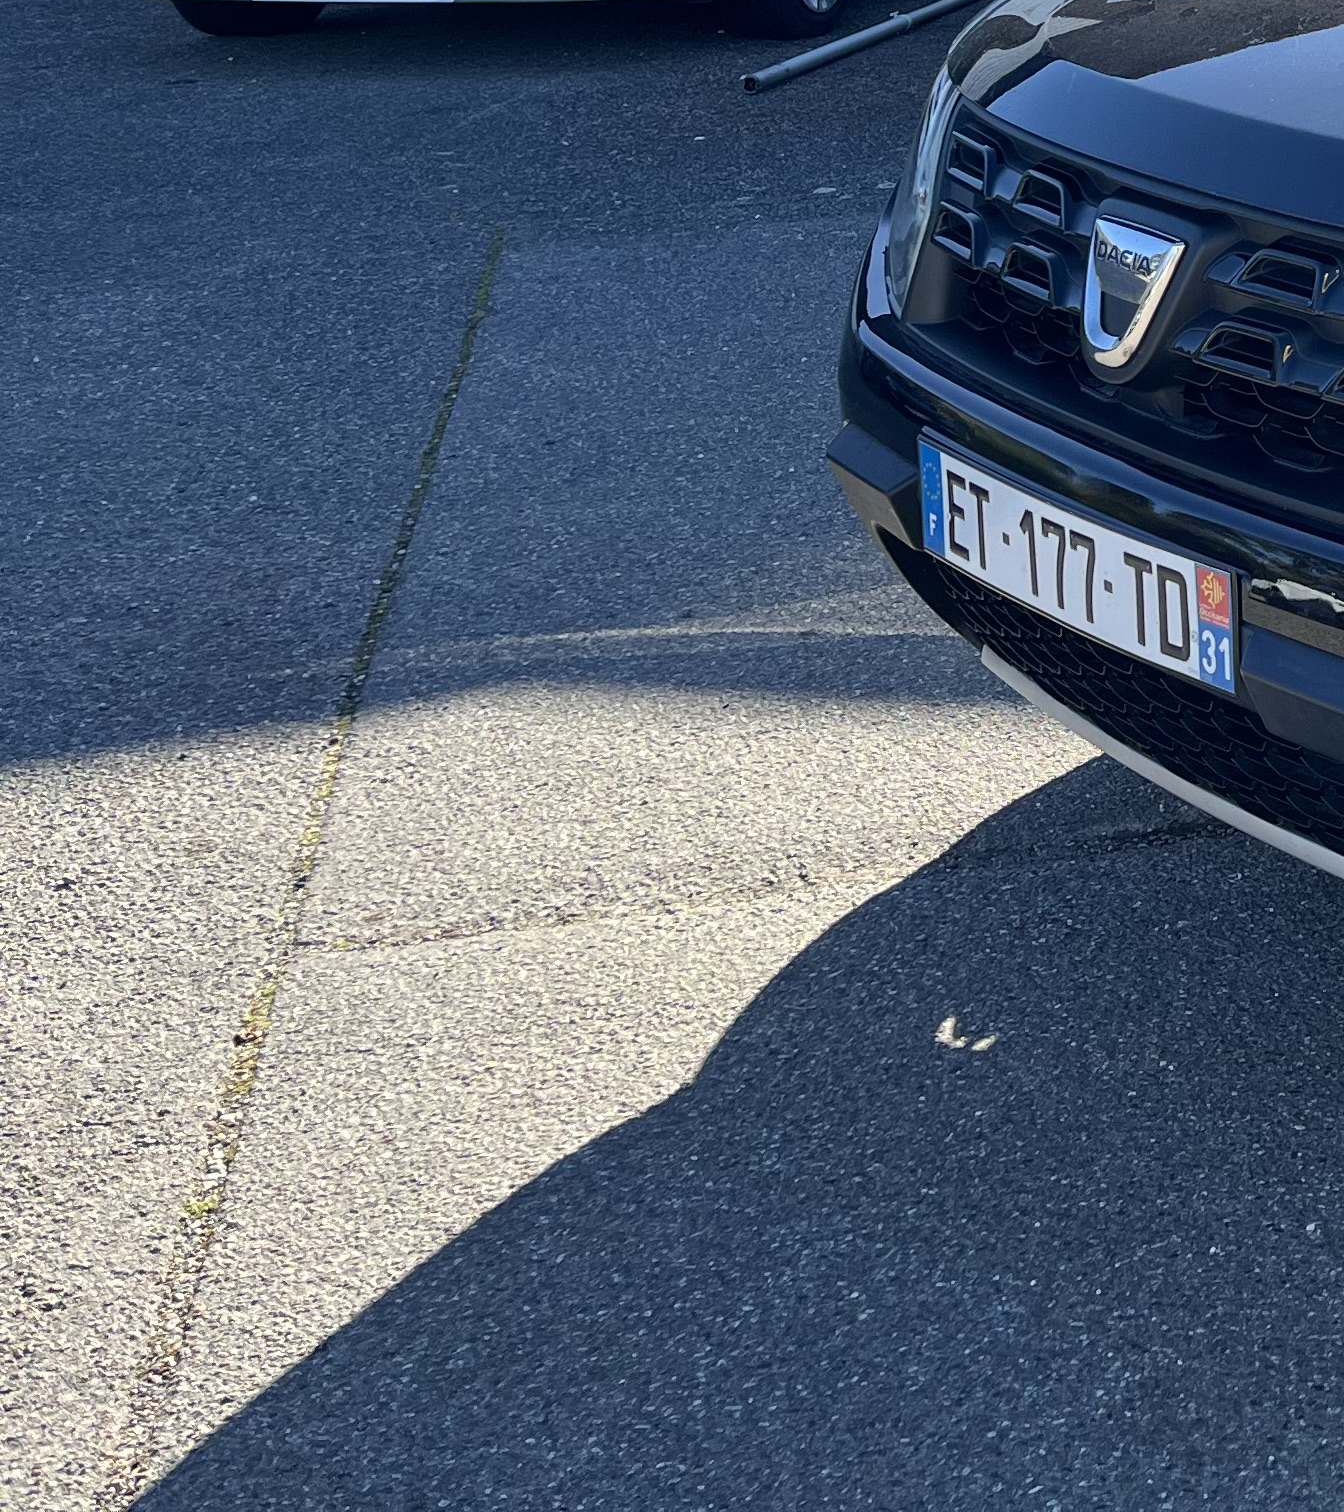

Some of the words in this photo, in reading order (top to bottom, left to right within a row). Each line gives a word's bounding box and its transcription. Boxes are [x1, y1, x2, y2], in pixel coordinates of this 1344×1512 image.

[1097, 240, 1151, 276] DACIA
[929, 512, 938, 536] F
[946, 469, 1191, 662] ET-177-TD
[1201, 629, 1231, 681] 31
